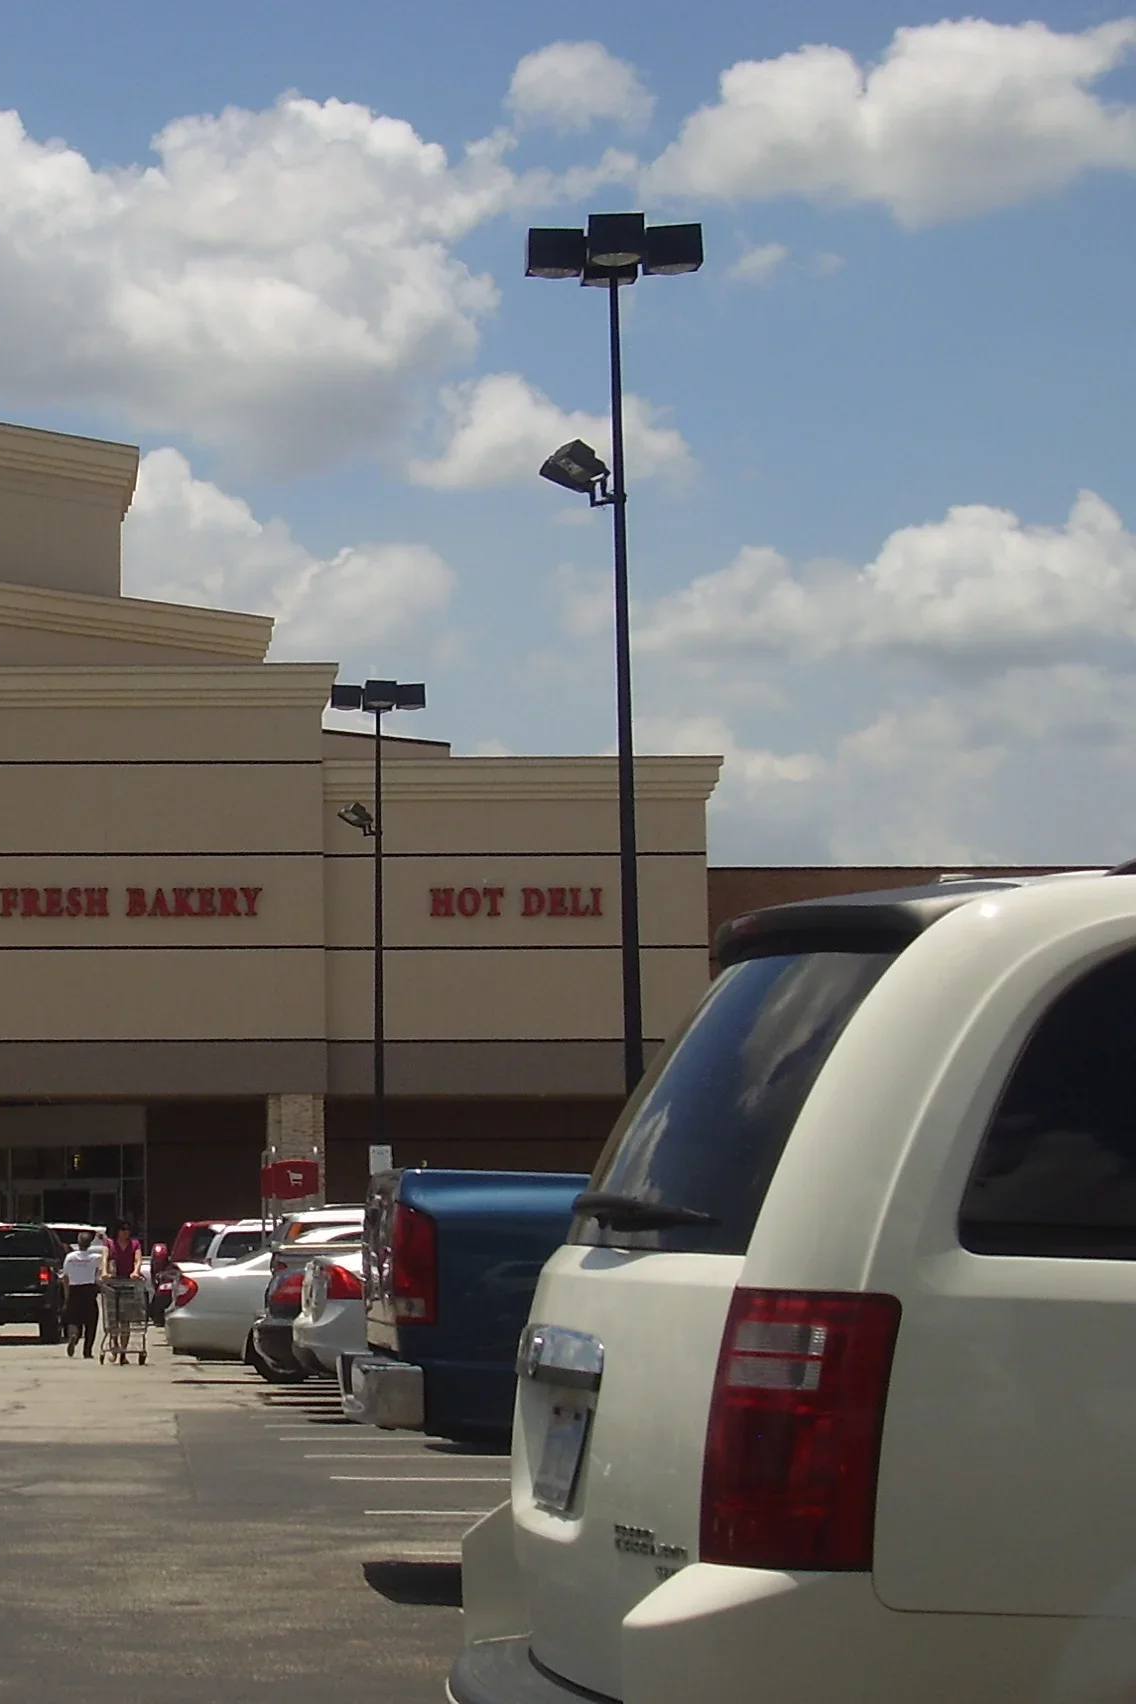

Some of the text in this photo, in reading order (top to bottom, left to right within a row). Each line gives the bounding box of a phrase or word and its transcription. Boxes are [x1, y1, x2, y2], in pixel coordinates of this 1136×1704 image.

[0, 887, 262, 917] FRESH BAKERY
[429, 887, 603, 917] HOT DELI
